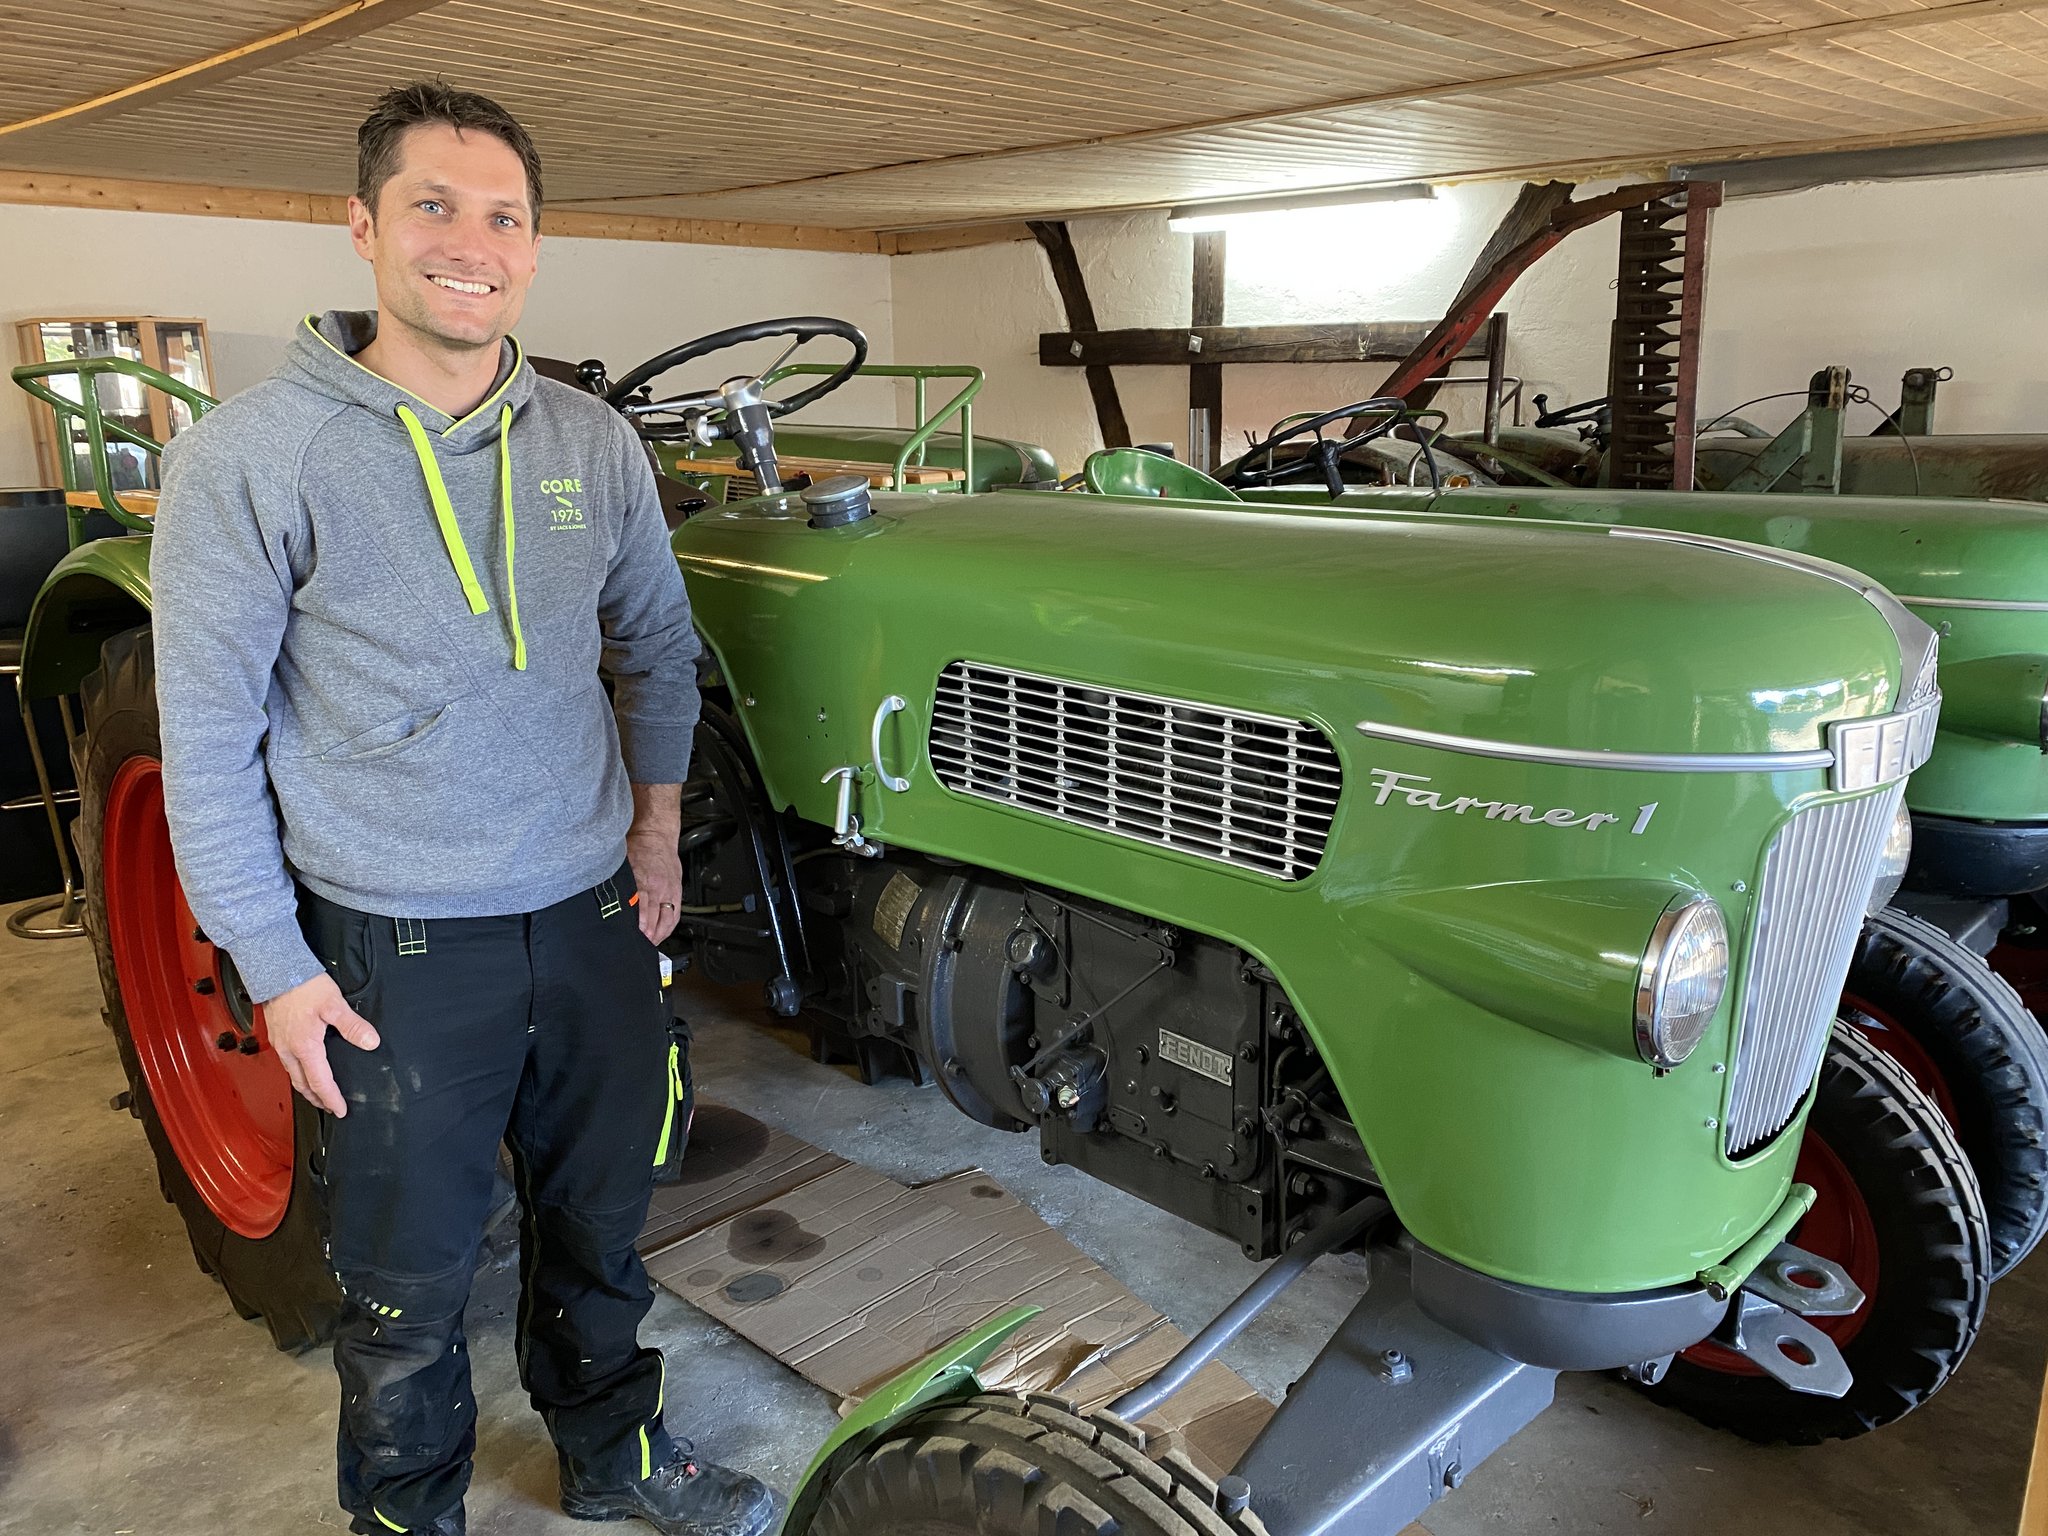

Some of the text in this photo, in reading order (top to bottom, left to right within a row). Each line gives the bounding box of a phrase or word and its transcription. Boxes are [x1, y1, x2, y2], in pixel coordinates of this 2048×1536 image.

[540, 478, 582, 494] CORE
[551, 508, 583, 523] 1975
[1370, 768, 1659, 835] Farmer 1
[1166, 1036, 1225, 1075] FENDT
